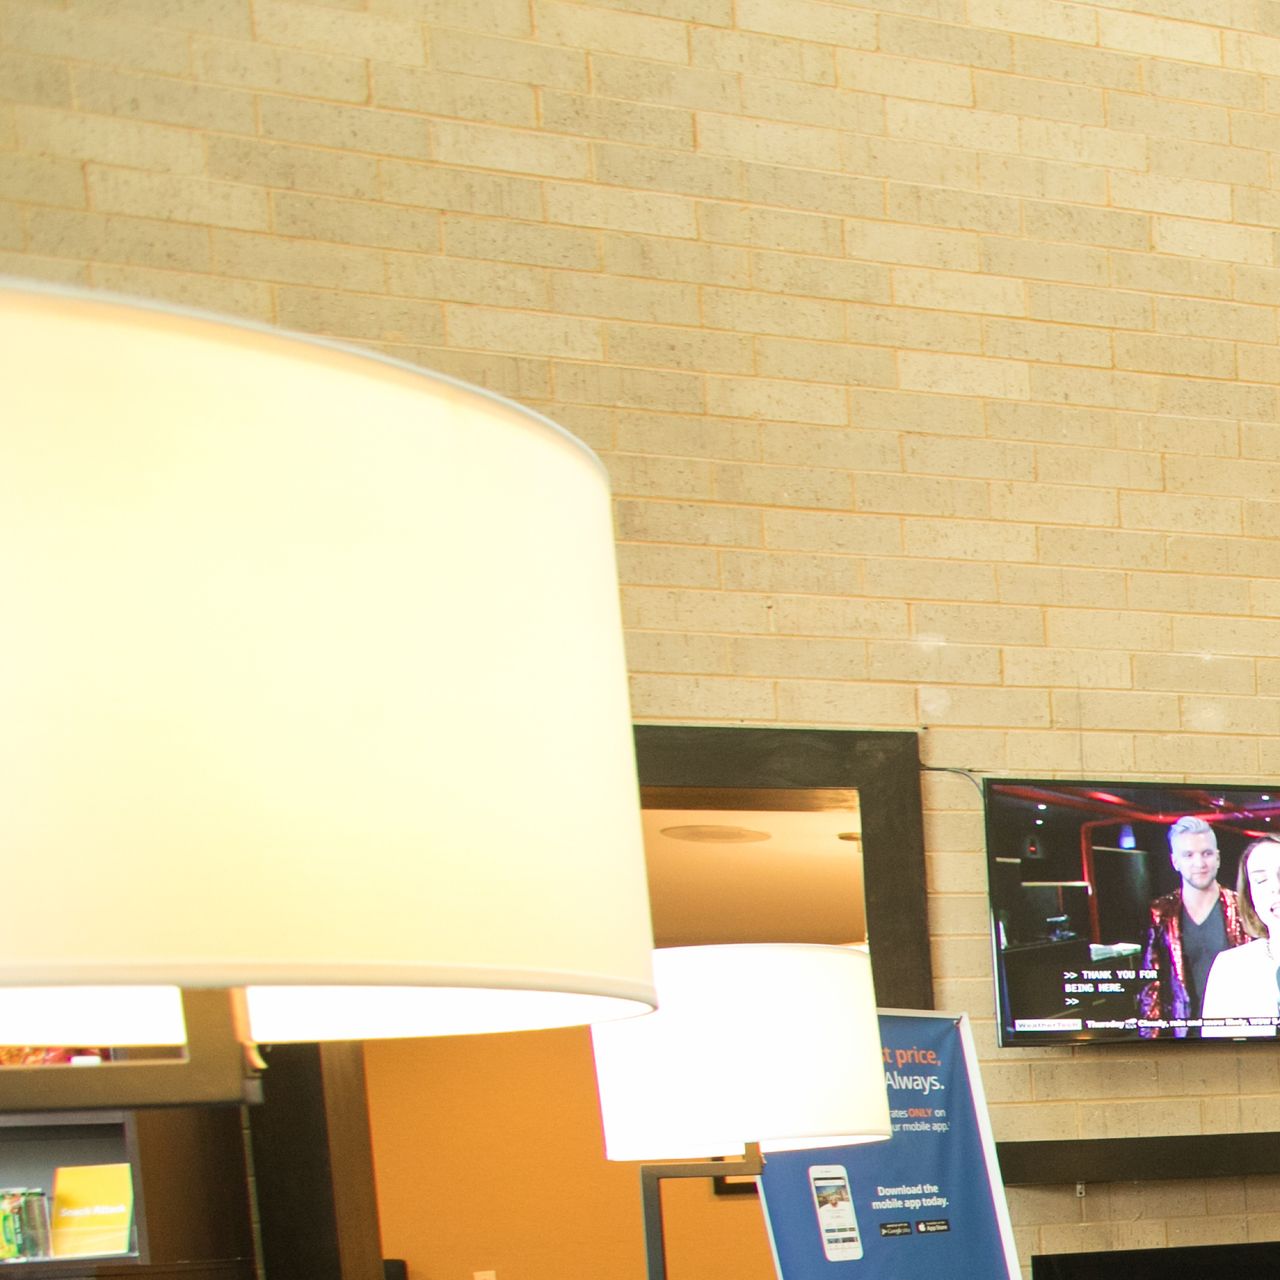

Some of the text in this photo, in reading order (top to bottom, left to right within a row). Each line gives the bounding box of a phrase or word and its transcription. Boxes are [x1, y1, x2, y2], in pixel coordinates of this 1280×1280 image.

[1082, 970, 1112, 980] THANK
[1116, 970, 1135, 980] YOU
[1139, 970, 1157, 979] FOR
[1065, 983, 1125, 993] BEING HERE.
[896, 1046, 942, 1068] price,
[885, 1070, 945, 1095] Always.
[908, 1108, 932, 1118] ONLY
[935, 1109, 946, 1117] on
[892, 1122, 901, 1131] ur
[903, 1121, 931, 1131] mobile
[877, 1183, 939, 1196] Download the
[872, 1196, 949, 1210] mobile app today.
